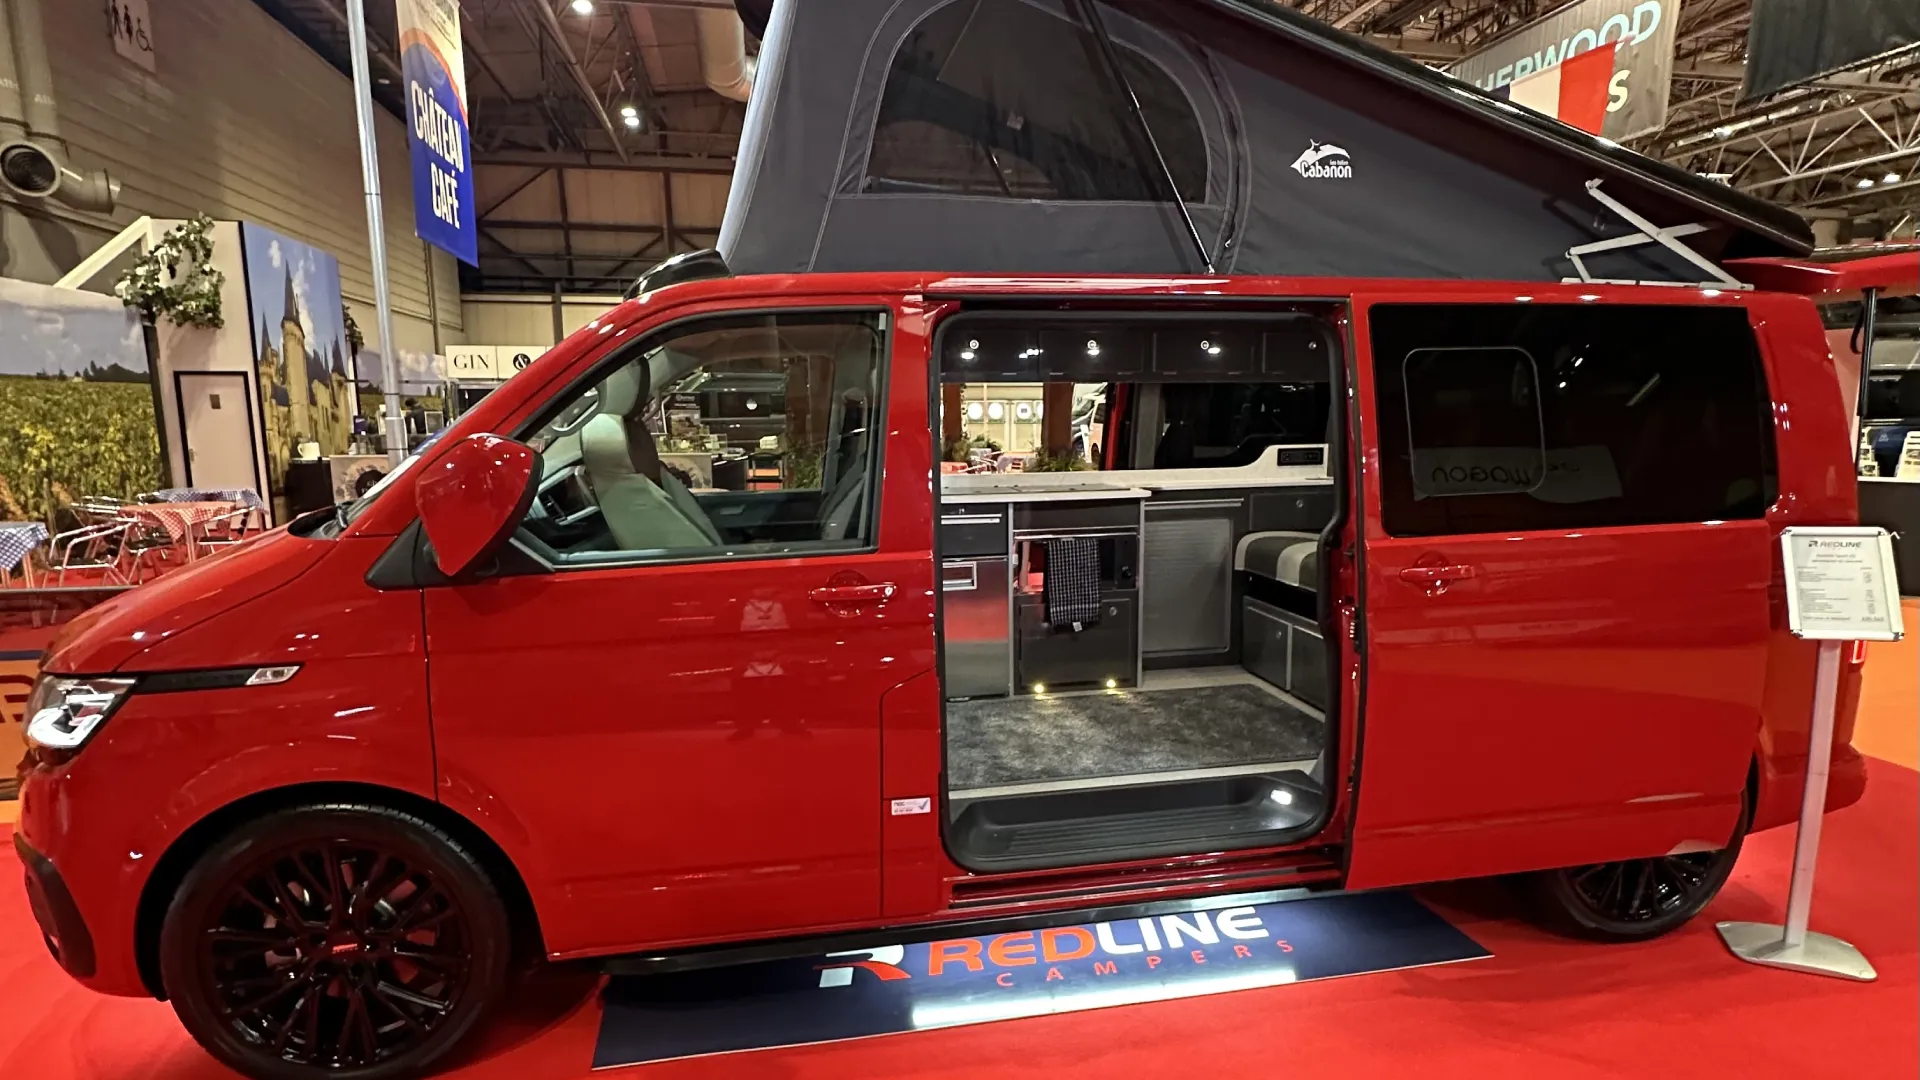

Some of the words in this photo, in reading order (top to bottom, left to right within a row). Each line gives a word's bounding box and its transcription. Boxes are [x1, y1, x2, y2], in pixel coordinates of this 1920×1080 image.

[411, 80, 465, 173] CHÂTEAU
[430, 162, 460, 230] CAFÉ
[1300, 160, 1352, 178] Cabanon
[453, 354, 489, 370] GIN
[928, 906, 1270, 976] REDLINE
[996, 940, 1294, 987] CAMPERS
